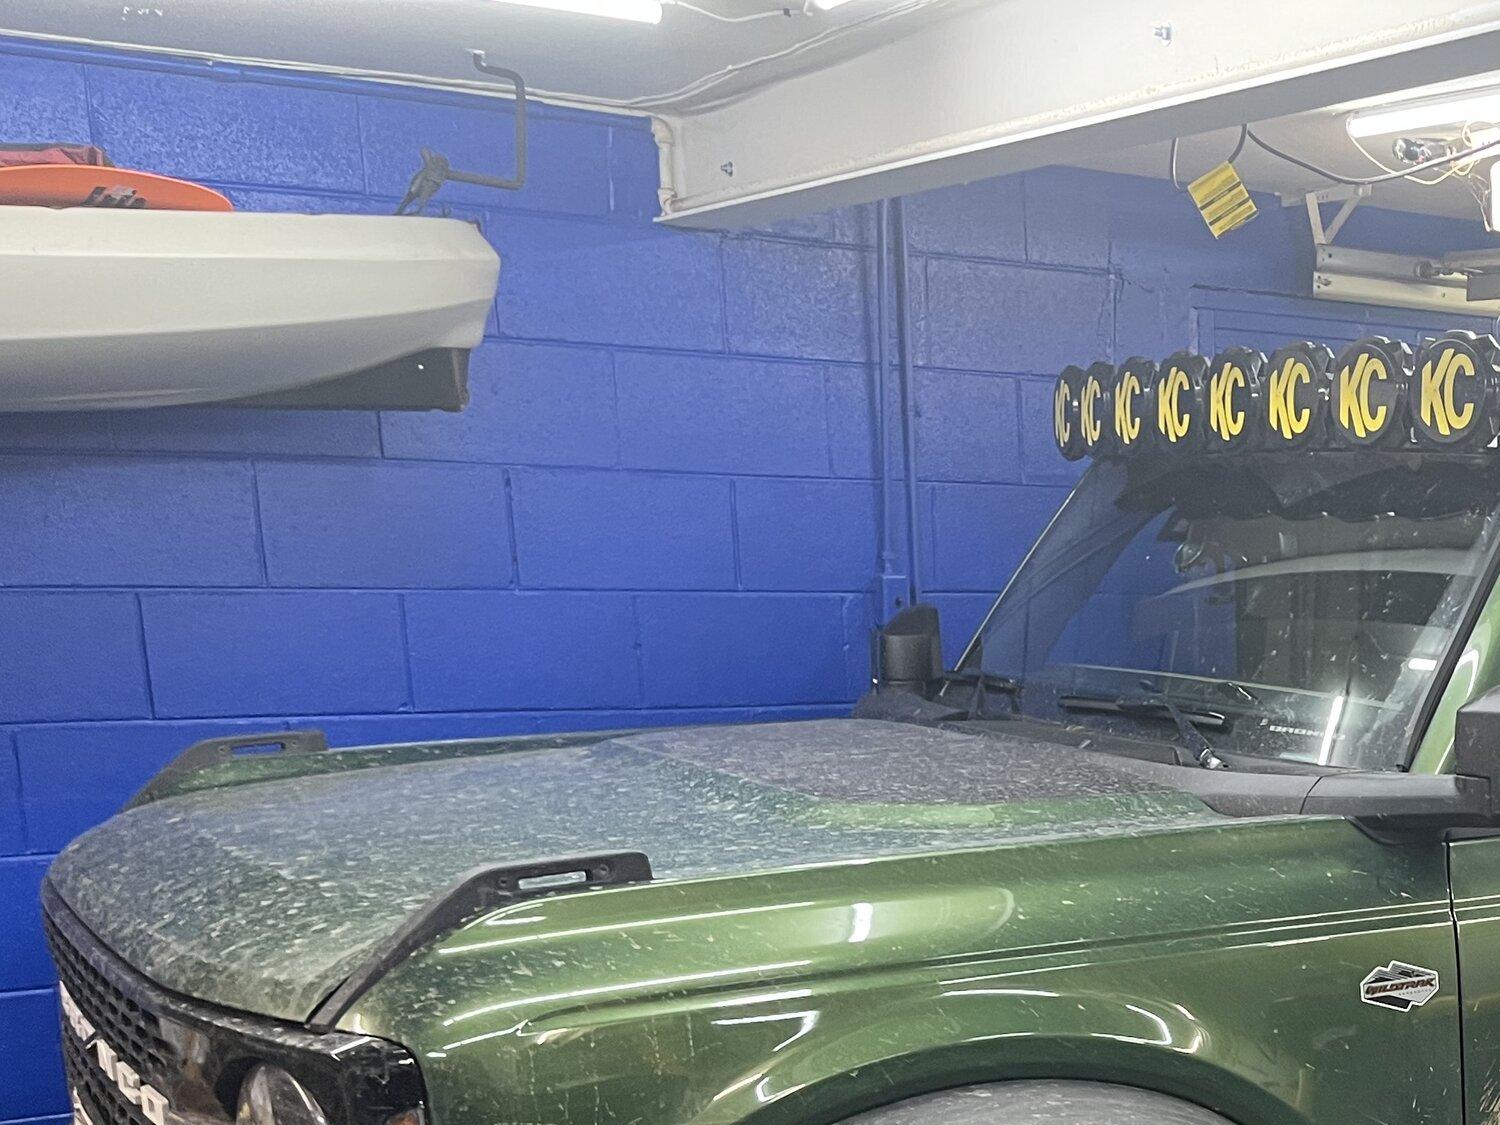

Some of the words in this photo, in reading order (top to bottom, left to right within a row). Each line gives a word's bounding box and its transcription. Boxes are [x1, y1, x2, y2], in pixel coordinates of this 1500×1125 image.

[1055, 380, 1070, 447] KC
[1081, 376, 1101, 446] KC
[1115, 371, 1140, 444] KC
[1158, 367, 1190, 442] KC
[1210, 362, 1245, 440] KC
[1269, 357, 1310, 439] KC
[1339, 353, 1387, 438] KC
[1420, 348, 1475, 436] KC
